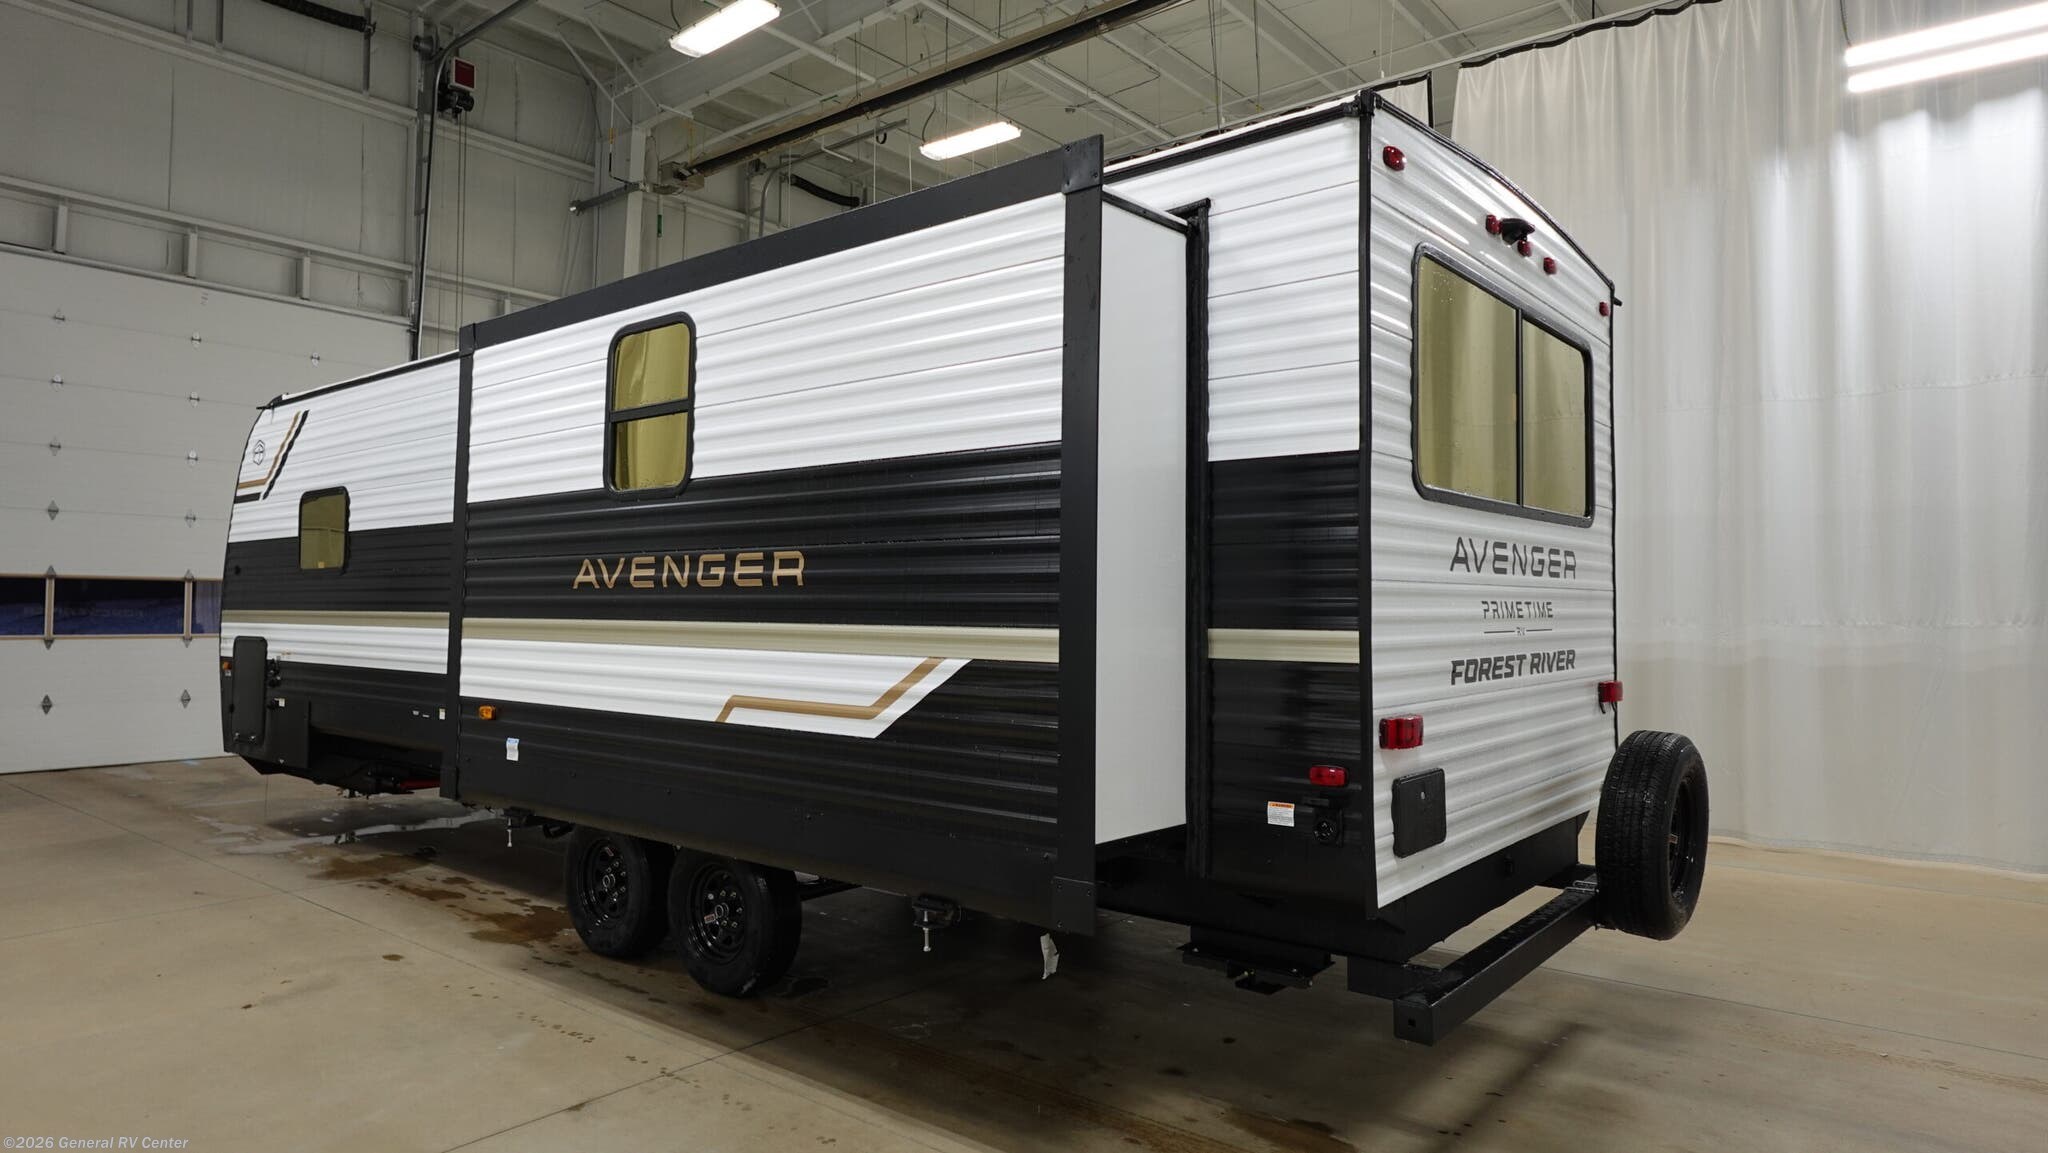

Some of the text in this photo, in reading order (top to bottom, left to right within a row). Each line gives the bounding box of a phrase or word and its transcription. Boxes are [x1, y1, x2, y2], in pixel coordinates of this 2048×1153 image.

[573, 551, 805, 589] AVENGER
[1450, 536, 1576, 579] AVENGER
[1481, 600, 1553, 619] PRIMETIME
[1516, 626, 1526, 636] RV
[1451, 649, 1576, 685] FOREST RIVER
